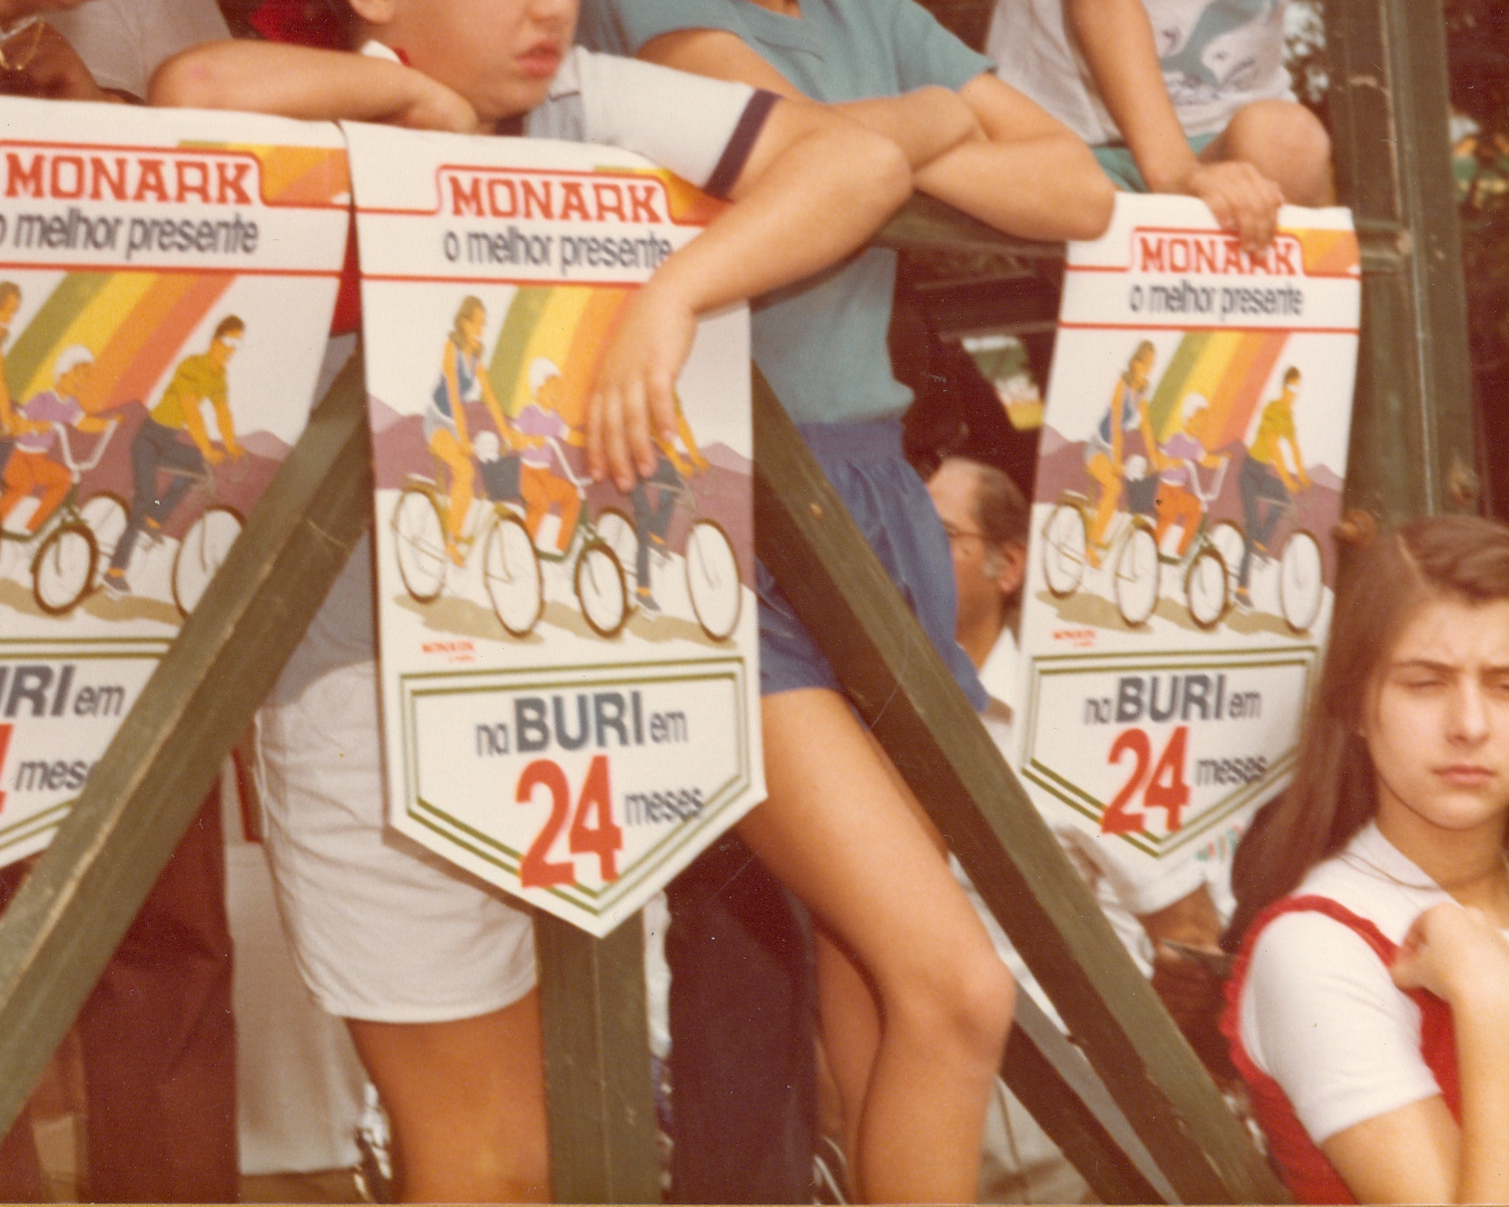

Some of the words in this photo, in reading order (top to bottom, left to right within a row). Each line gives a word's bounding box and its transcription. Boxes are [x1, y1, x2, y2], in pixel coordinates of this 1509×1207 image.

[4, 152, 253, 206] MONARK
[447, 175, 663, 224] MONARK
[13, 205, 121, 252] melhor
[125, 211, 259, 262] presente
[443, 231, 460, 263] o
[467, 224, 556, 267] melhor
[559, 231, 673, 275] presente
[75, 685, 124, 717] em
[476, 723, 508, 756] na
[514, 692, 644, 752] BURI
[650, 709, 687, 742] em
[1084, 697, 1112, 725] na
[1115, 674, 1227, 724] BURI
[1228, 689, 1263, 720] em
[14, 759, 99, 791] mes
[1101, 725, 1191, 835] 24
[1196, 756, 1268, 786] meses
[514, 754, 624, 889] 24
[623, 785, 707, 828] meses
